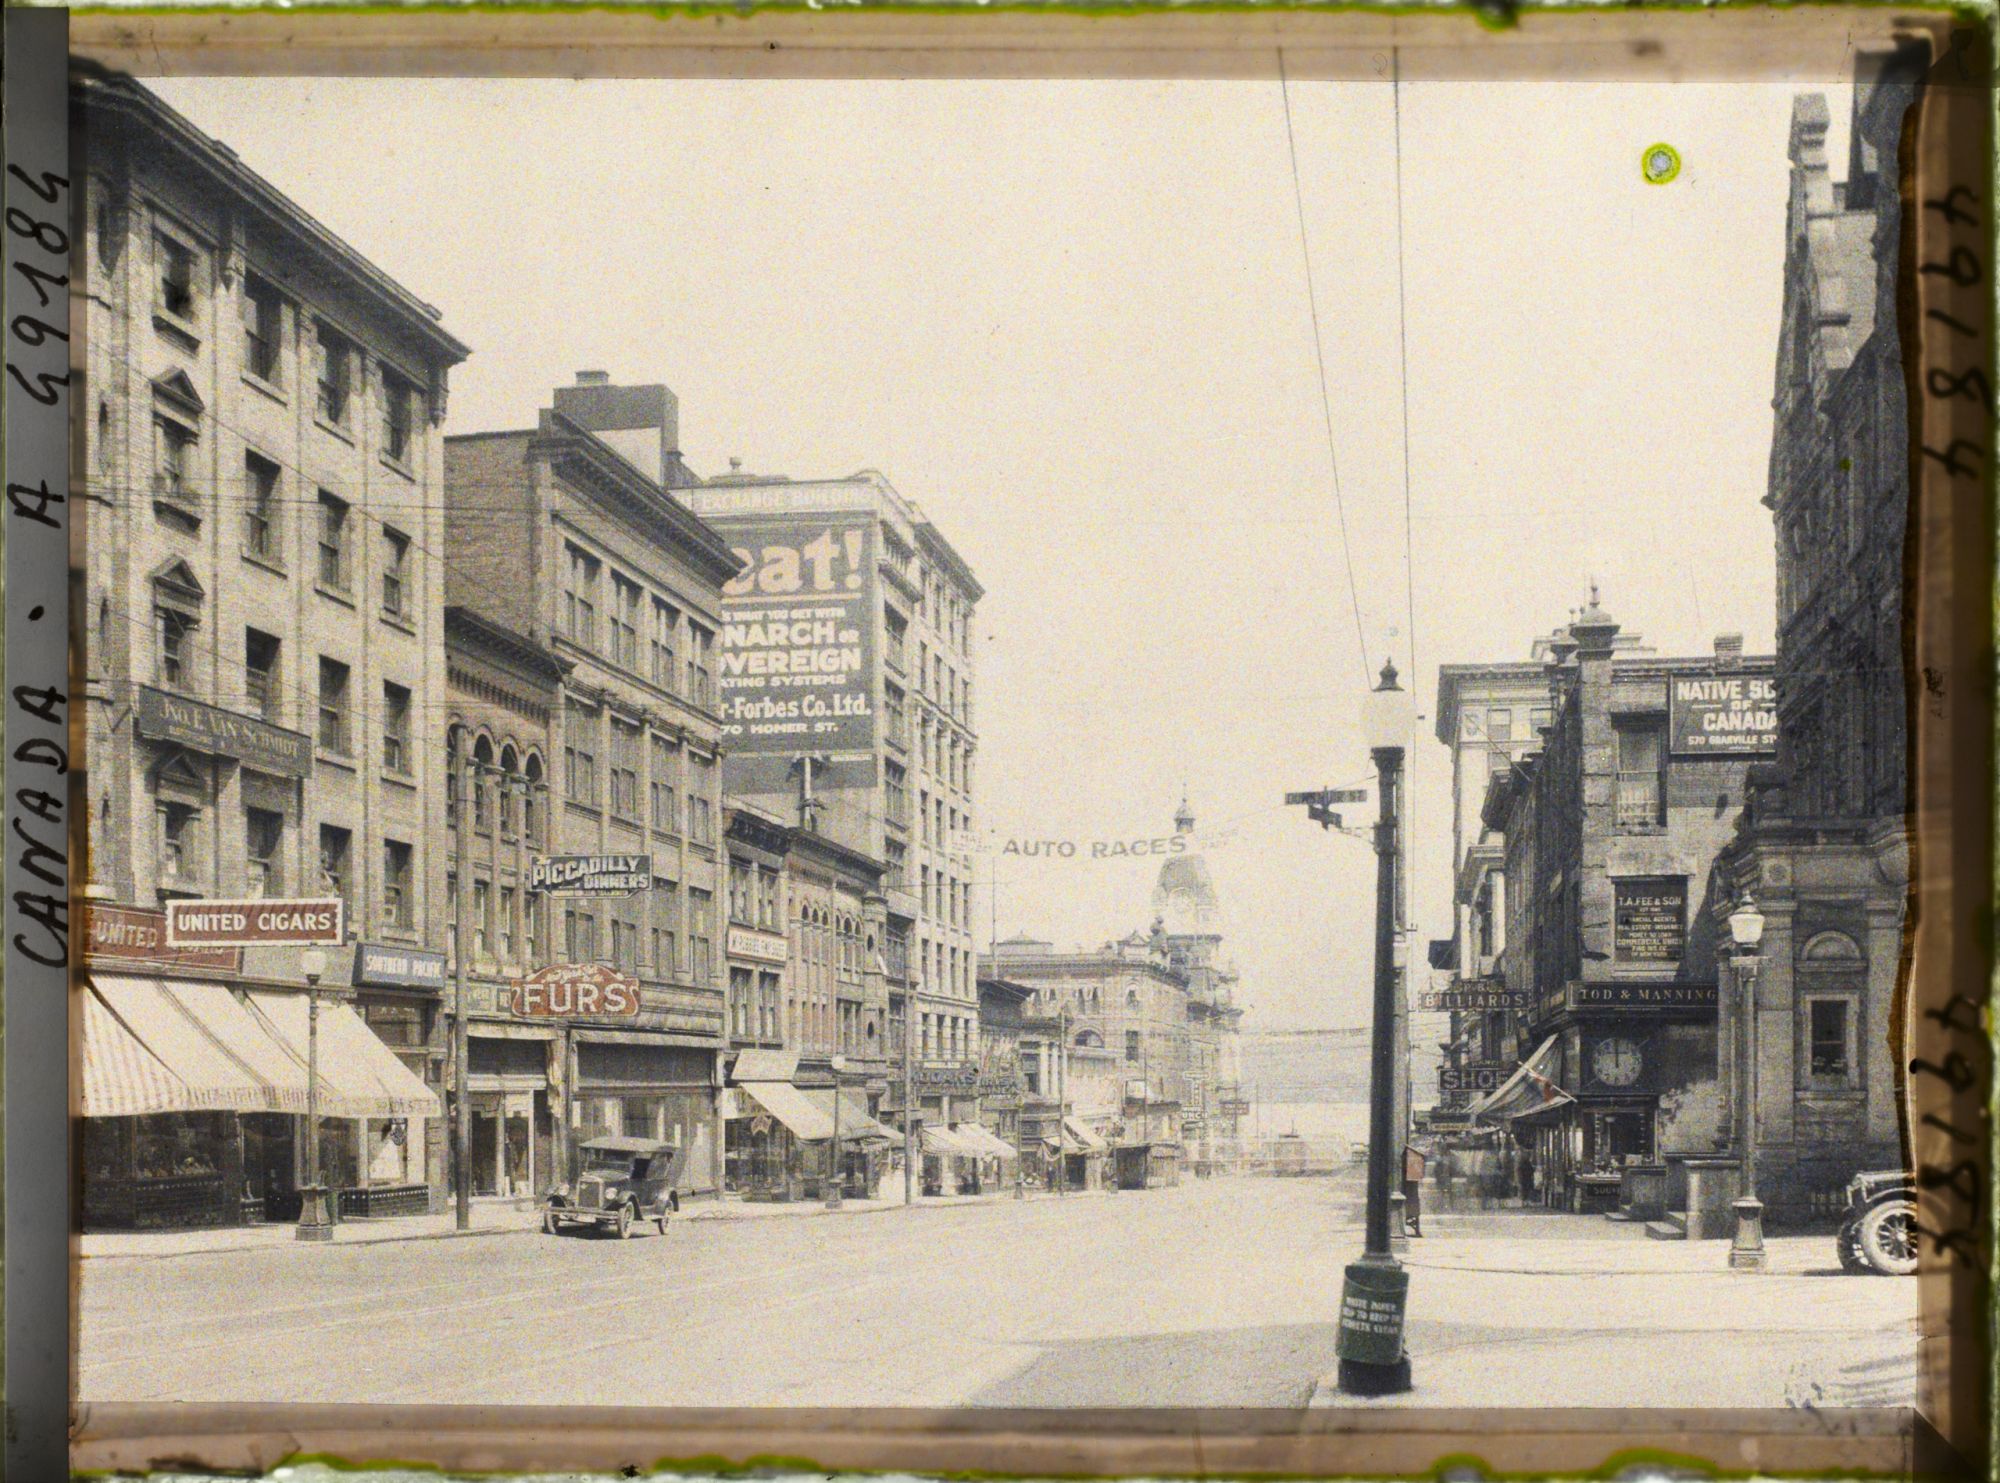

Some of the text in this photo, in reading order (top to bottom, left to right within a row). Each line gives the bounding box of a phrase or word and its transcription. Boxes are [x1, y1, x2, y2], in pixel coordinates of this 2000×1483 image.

[790, 608, 813, 619] GET
[770, 674, 846, 687] SYSTEMS
[1678, 680, 1742, 700] NATIVE
[833, 693, 872, 716] Ltd.
[1730, 700, 1753, 710] OF
[6, 479, 68, 968] CANADA A
[750, 723, 808, 734] HOMER
[1708, 735, 1758, 744] GRANVILLE
[1002, 838, 1076, 858] AUTO
[1091, 835, 1186, 858] RACES
[532, 856, 640, 886] PICCADILLY
[1662, 896, 1682, 905] SON
[178, 912, 331, 932] UNITED CIGARS
[96, 921, 158, 949] UNITED
[522, 983, 627, 1013] FURS
[1425, 993, 1524, 1007] BILLIARDS
[1579, 989, 1716, 1000] TOD & MANNING
